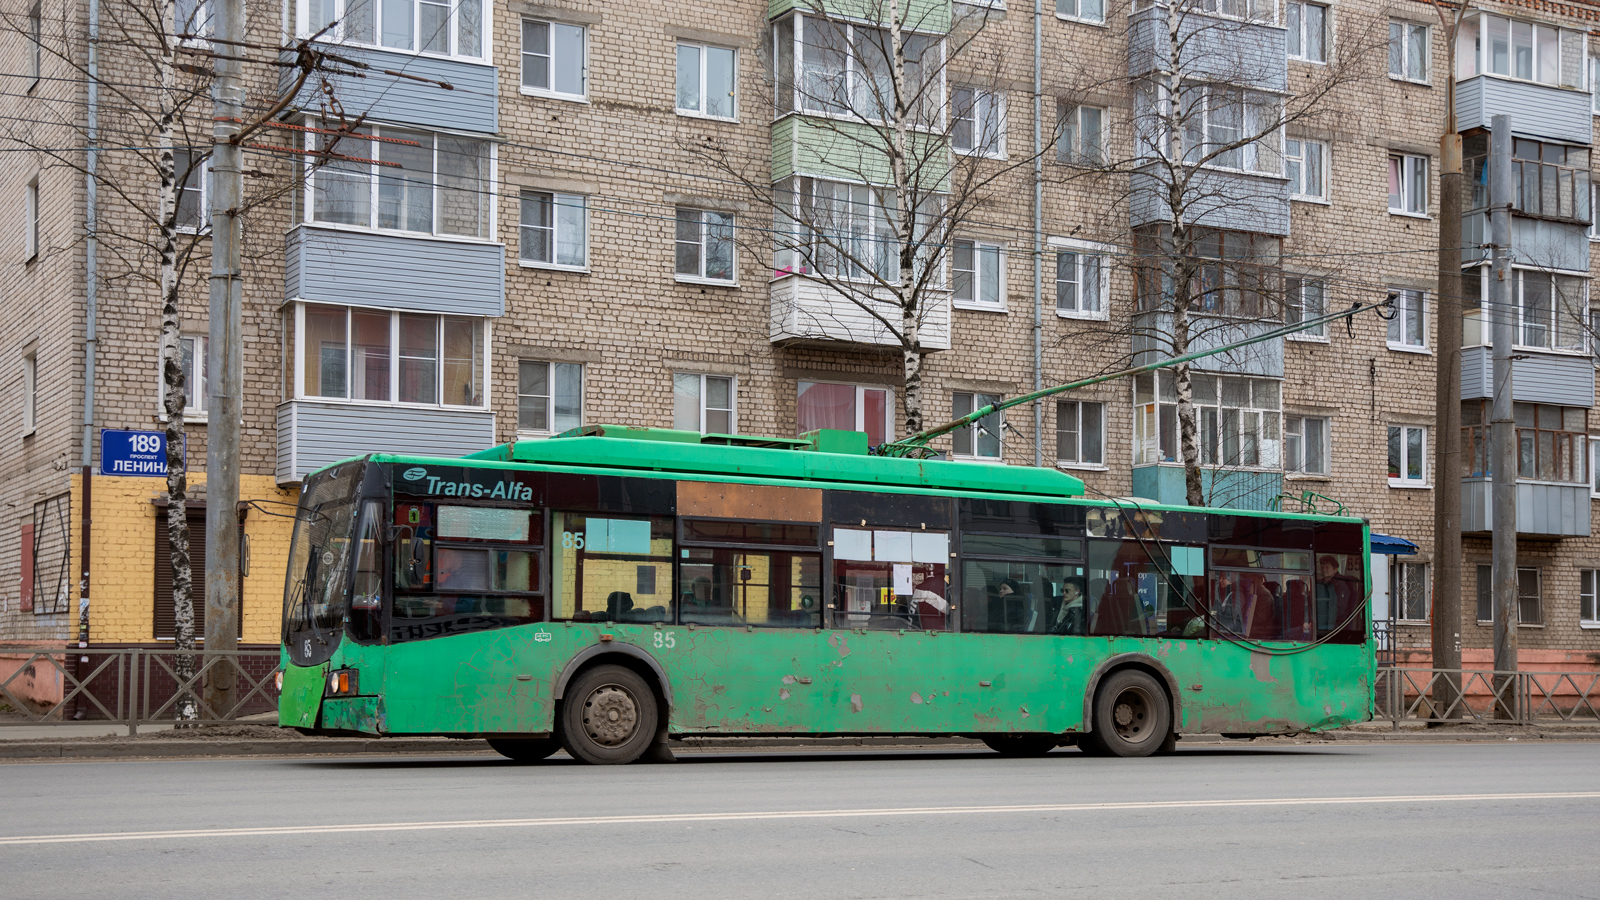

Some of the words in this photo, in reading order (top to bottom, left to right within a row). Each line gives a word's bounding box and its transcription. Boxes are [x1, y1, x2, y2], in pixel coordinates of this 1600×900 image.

[128, 434, 161, 453] 189
[426, 475, 533, 501] Trans-Alfa
[561, 531, 585, 550] 85
[304, 639, 312, 658] 85
[653, 631, 676, 649] 85
